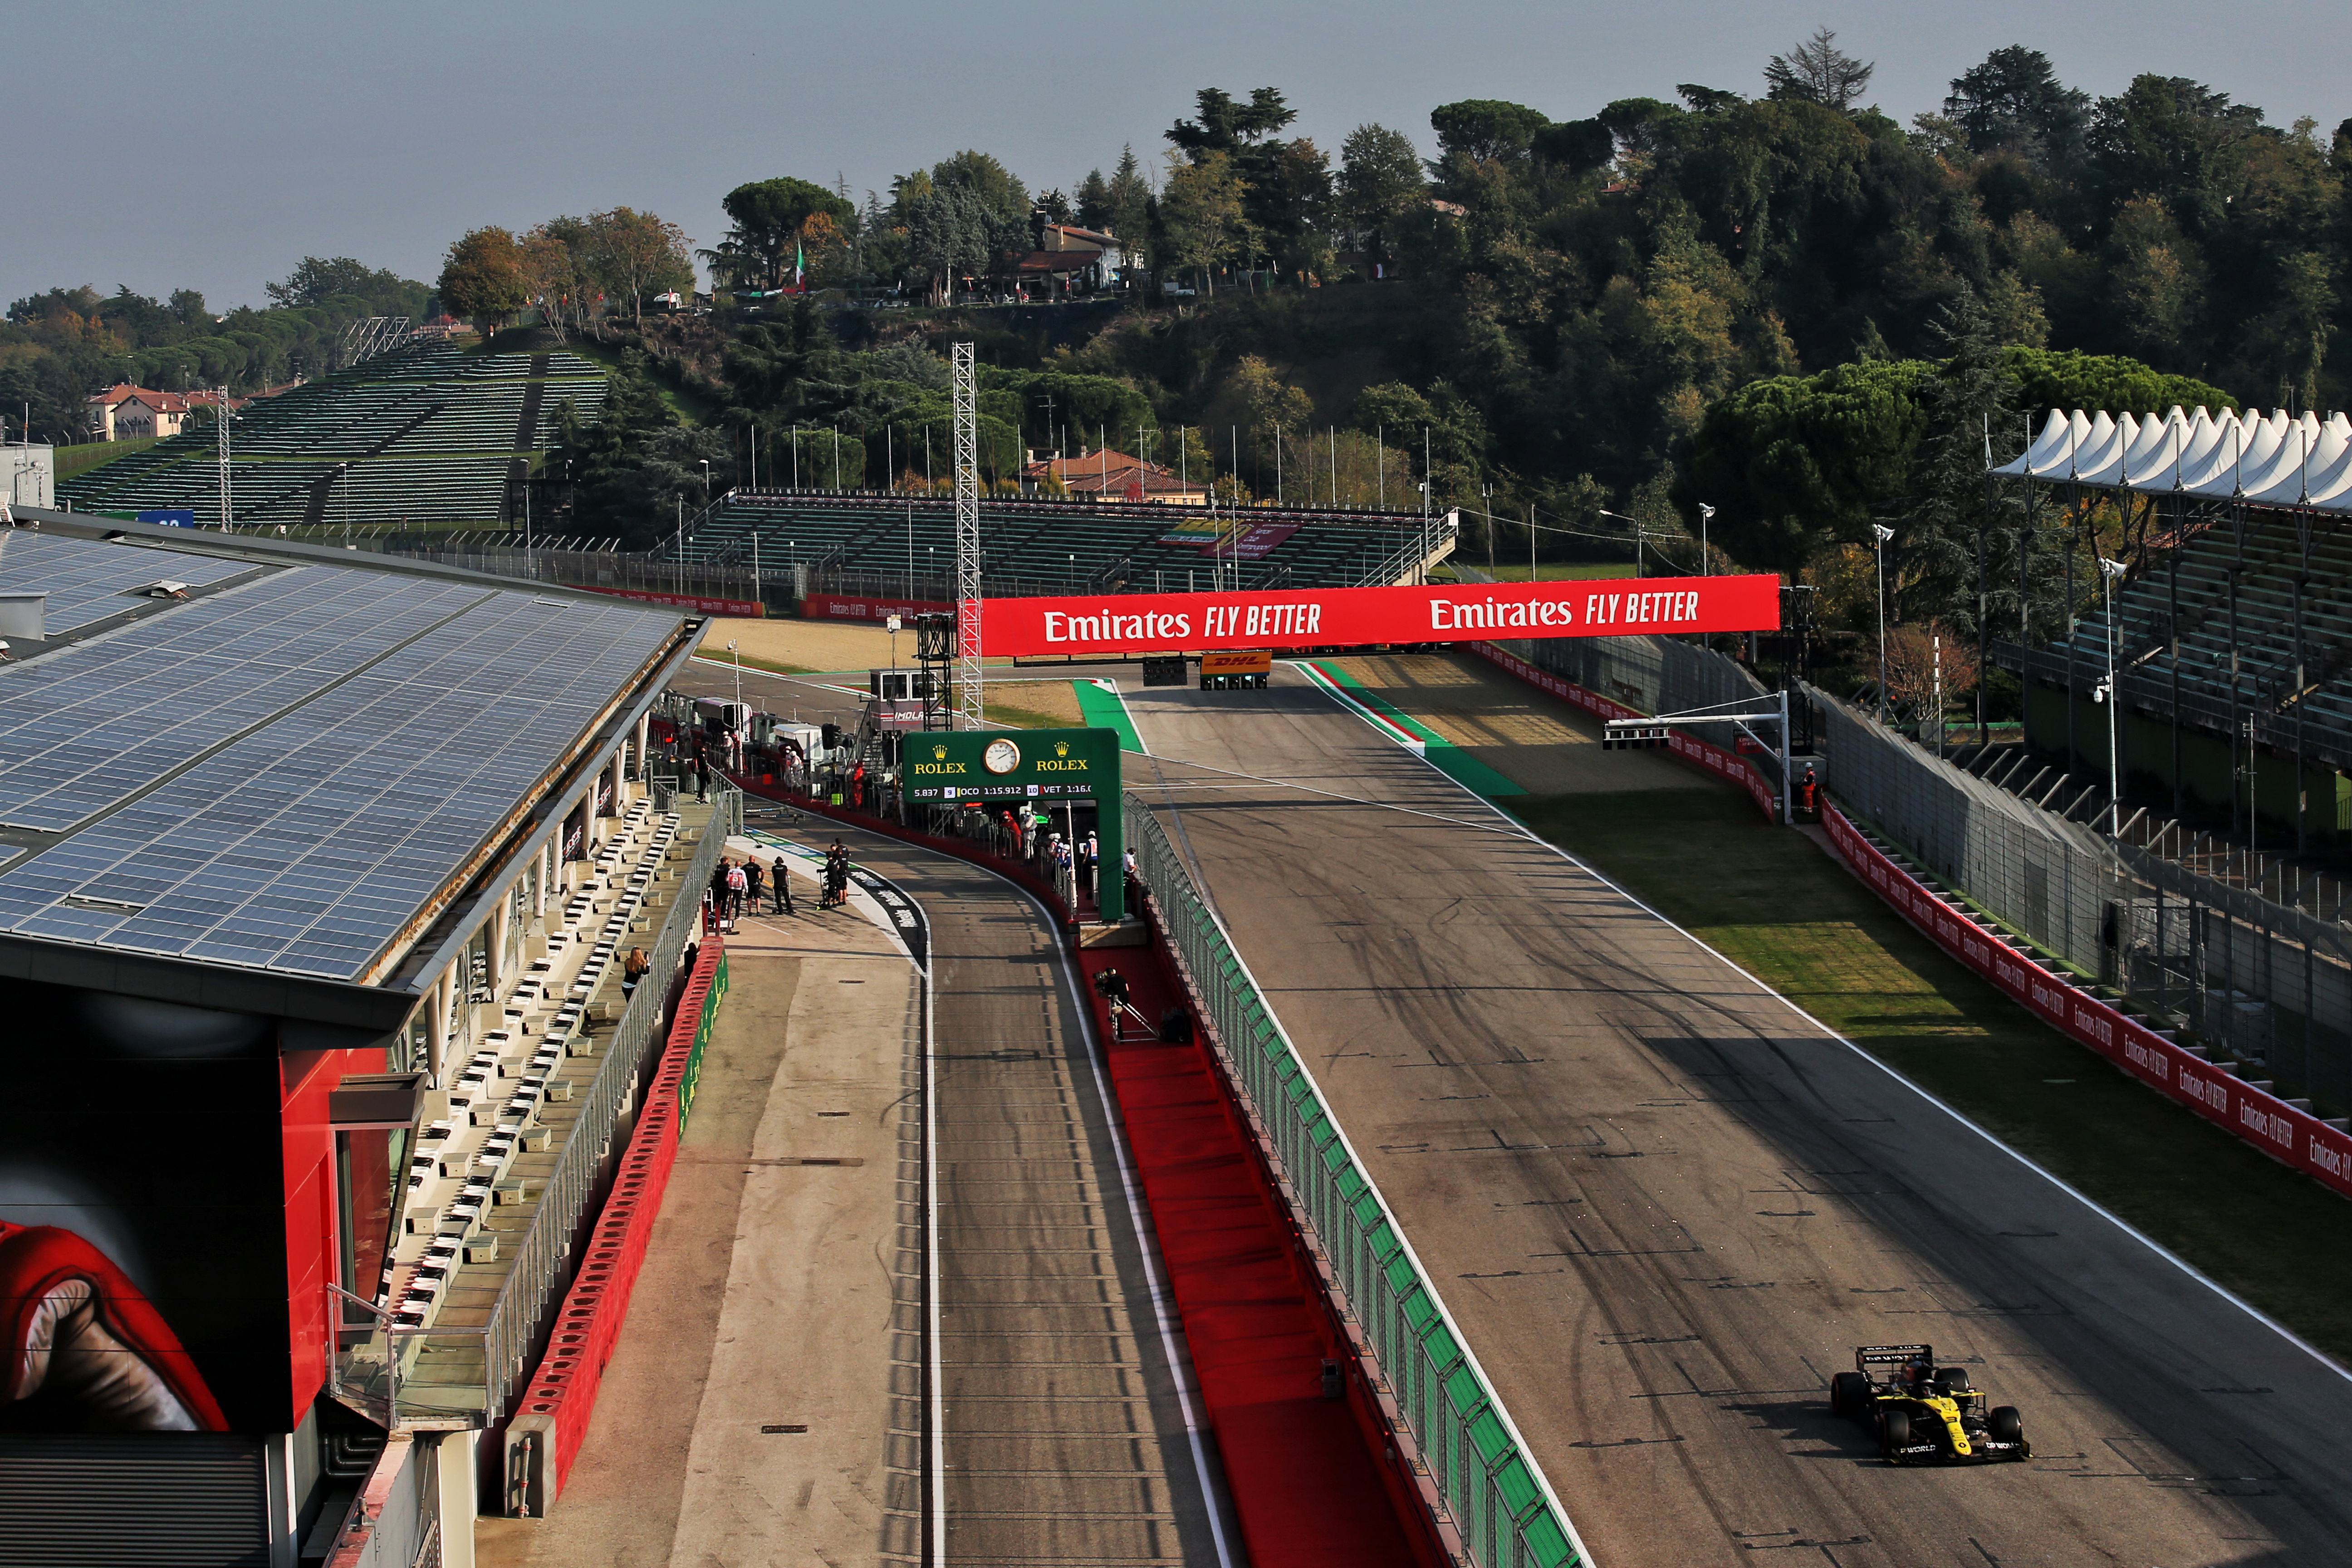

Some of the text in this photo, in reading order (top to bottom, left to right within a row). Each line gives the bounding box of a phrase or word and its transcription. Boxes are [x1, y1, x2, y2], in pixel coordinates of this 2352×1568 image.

[830, 602, 849, 614] Emirates
[1430, 591, 1698, 629] Emirates FLY BETTER
[1044, 604, 1321, 642] Emirates FLY BETTER
[1213, 656, 1258, 666] DHL
[895, 711, 924, 720] IMOLA
[915, 763, 966, 774] ROLEX
[1036, 760, 1088, 771] ROLEX
[985, 787, 1021, 795] 1:15.912
[2180, 1065, 2204, 1101] Emirates
[2240, 1098, 2267, 1136] Emirates
[2277, 1117, 2292, 1150] BETTER
[2310, 1134, 2351, 1182] Emirates FLY
[1907, 1445, 1936, 1453] WORLD
